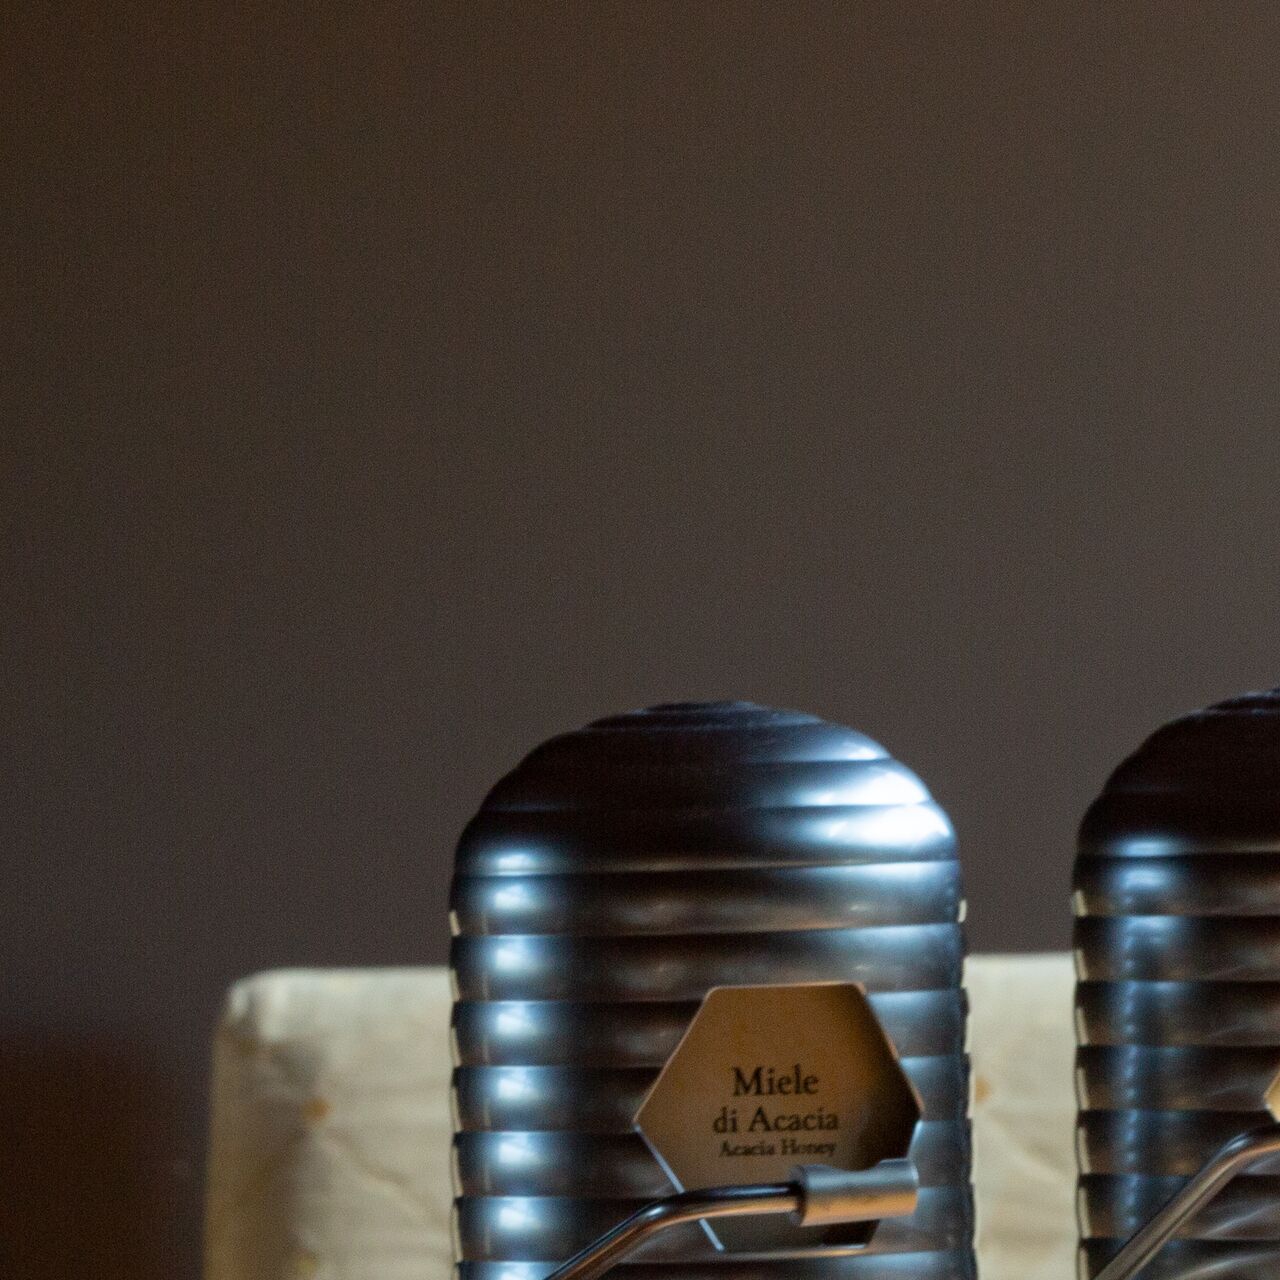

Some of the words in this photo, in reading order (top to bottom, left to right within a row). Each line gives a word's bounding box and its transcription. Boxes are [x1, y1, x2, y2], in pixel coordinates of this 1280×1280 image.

[731, 1063, 819, 1097] Miele
[712, 1106, 738, 1133] di
[748, 1106, 839, 1132] Acacia
[719, 1140, 775, 1157] Acacia
[781, 1139, 836, 1158] Honey
